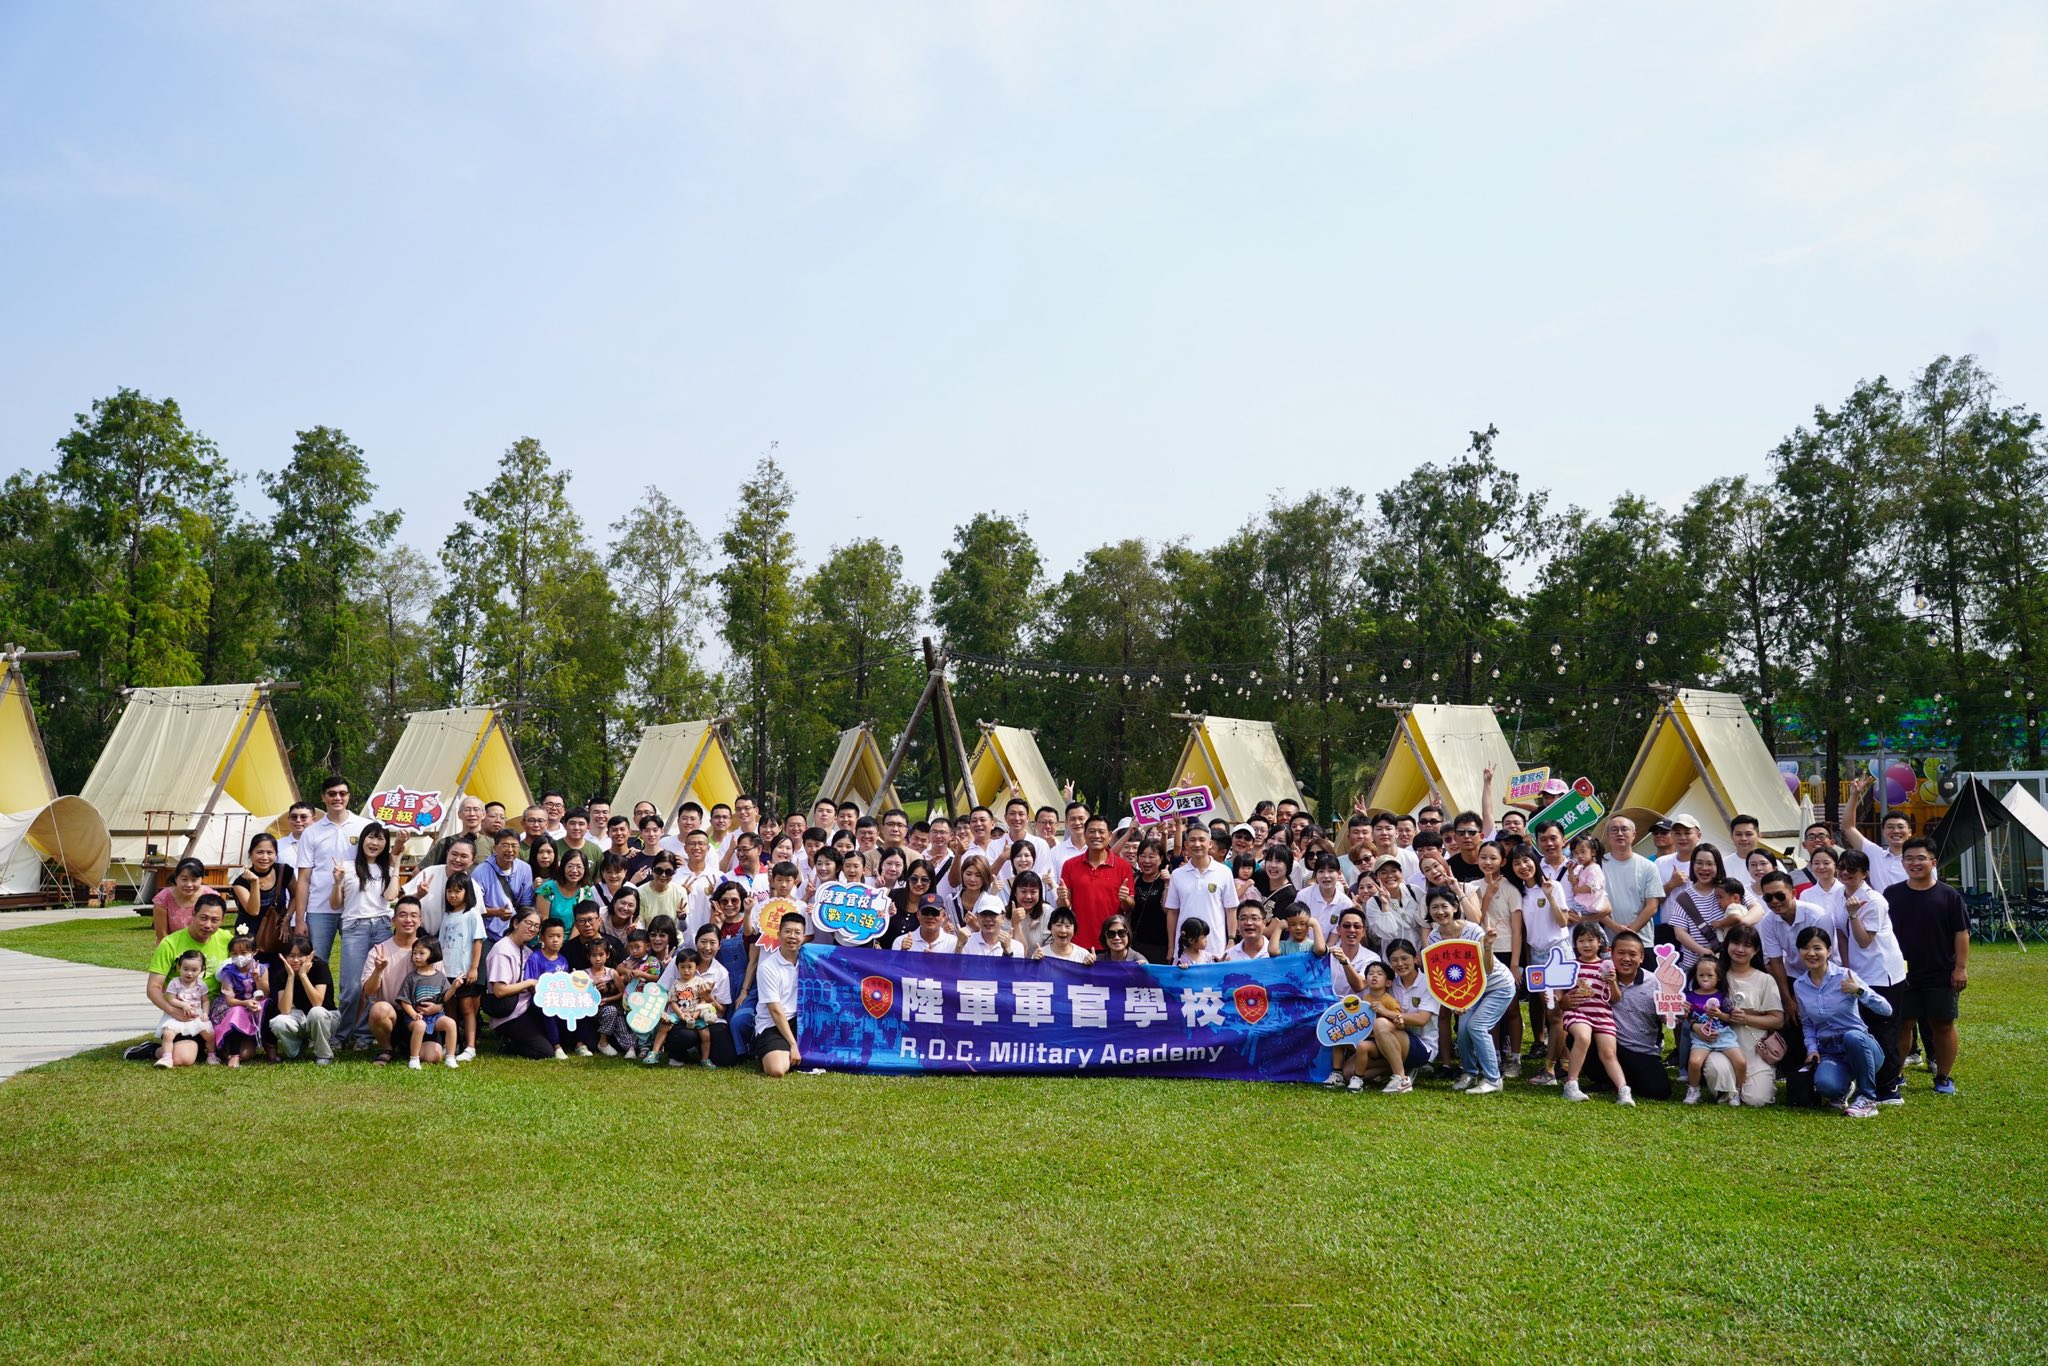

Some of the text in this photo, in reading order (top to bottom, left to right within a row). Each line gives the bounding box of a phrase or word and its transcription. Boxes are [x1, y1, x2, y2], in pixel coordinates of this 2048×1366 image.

[384, 792, 419, 809] 陸官
[1139, 796, 1204, 815] 我 陸官
[376, 806, 433, 827] 超級棒
[820, 889, 871, 909] 陸軍官校
[543, 991, 594, 1008] 我最棒
[901, 977, 1226, 1029] 陸軍軍官學校
[1658, 1001, 1682, 1012] 陸官
[1661, 993, 1683, 1001] love
[1325, 1009, 1347, 1026] 今日
[1327, 1012, 1371, 1043] 我最棒
[900, 1037, 1225, 1069] R.O.C. Military Academy
